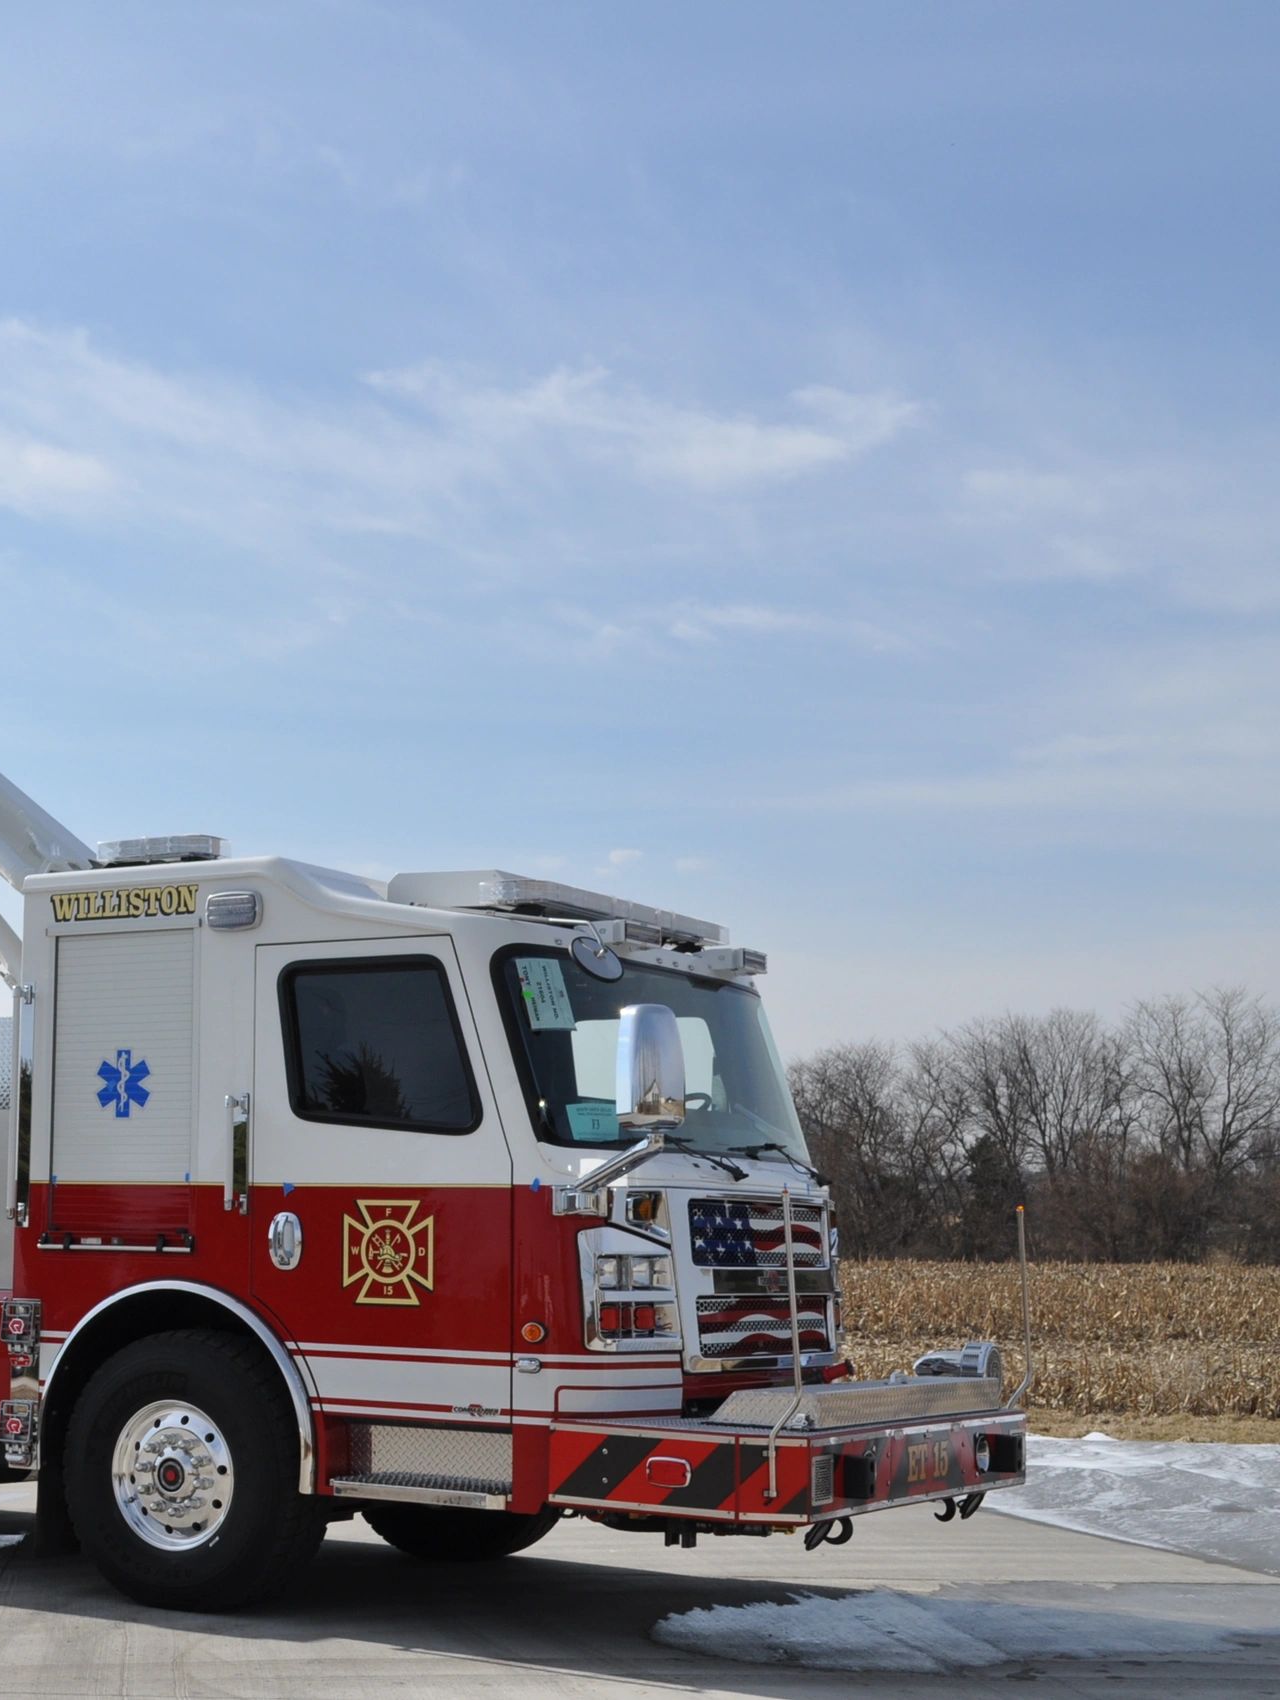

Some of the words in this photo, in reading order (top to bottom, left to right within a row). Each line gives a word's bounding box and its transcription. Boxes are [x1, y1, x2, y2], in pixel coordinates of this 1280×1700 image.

[51, 884, 199, 922] WILLISTON
[385, 1207, 392, 1217] F
[350, 1246, 360, 1255] W
[418, 1247, 426, 1257] D
[383, 1285, 393, 1295] 15
[907, 1443, 929, 1482] ET
[933, 1440, 950, 1478] 15
